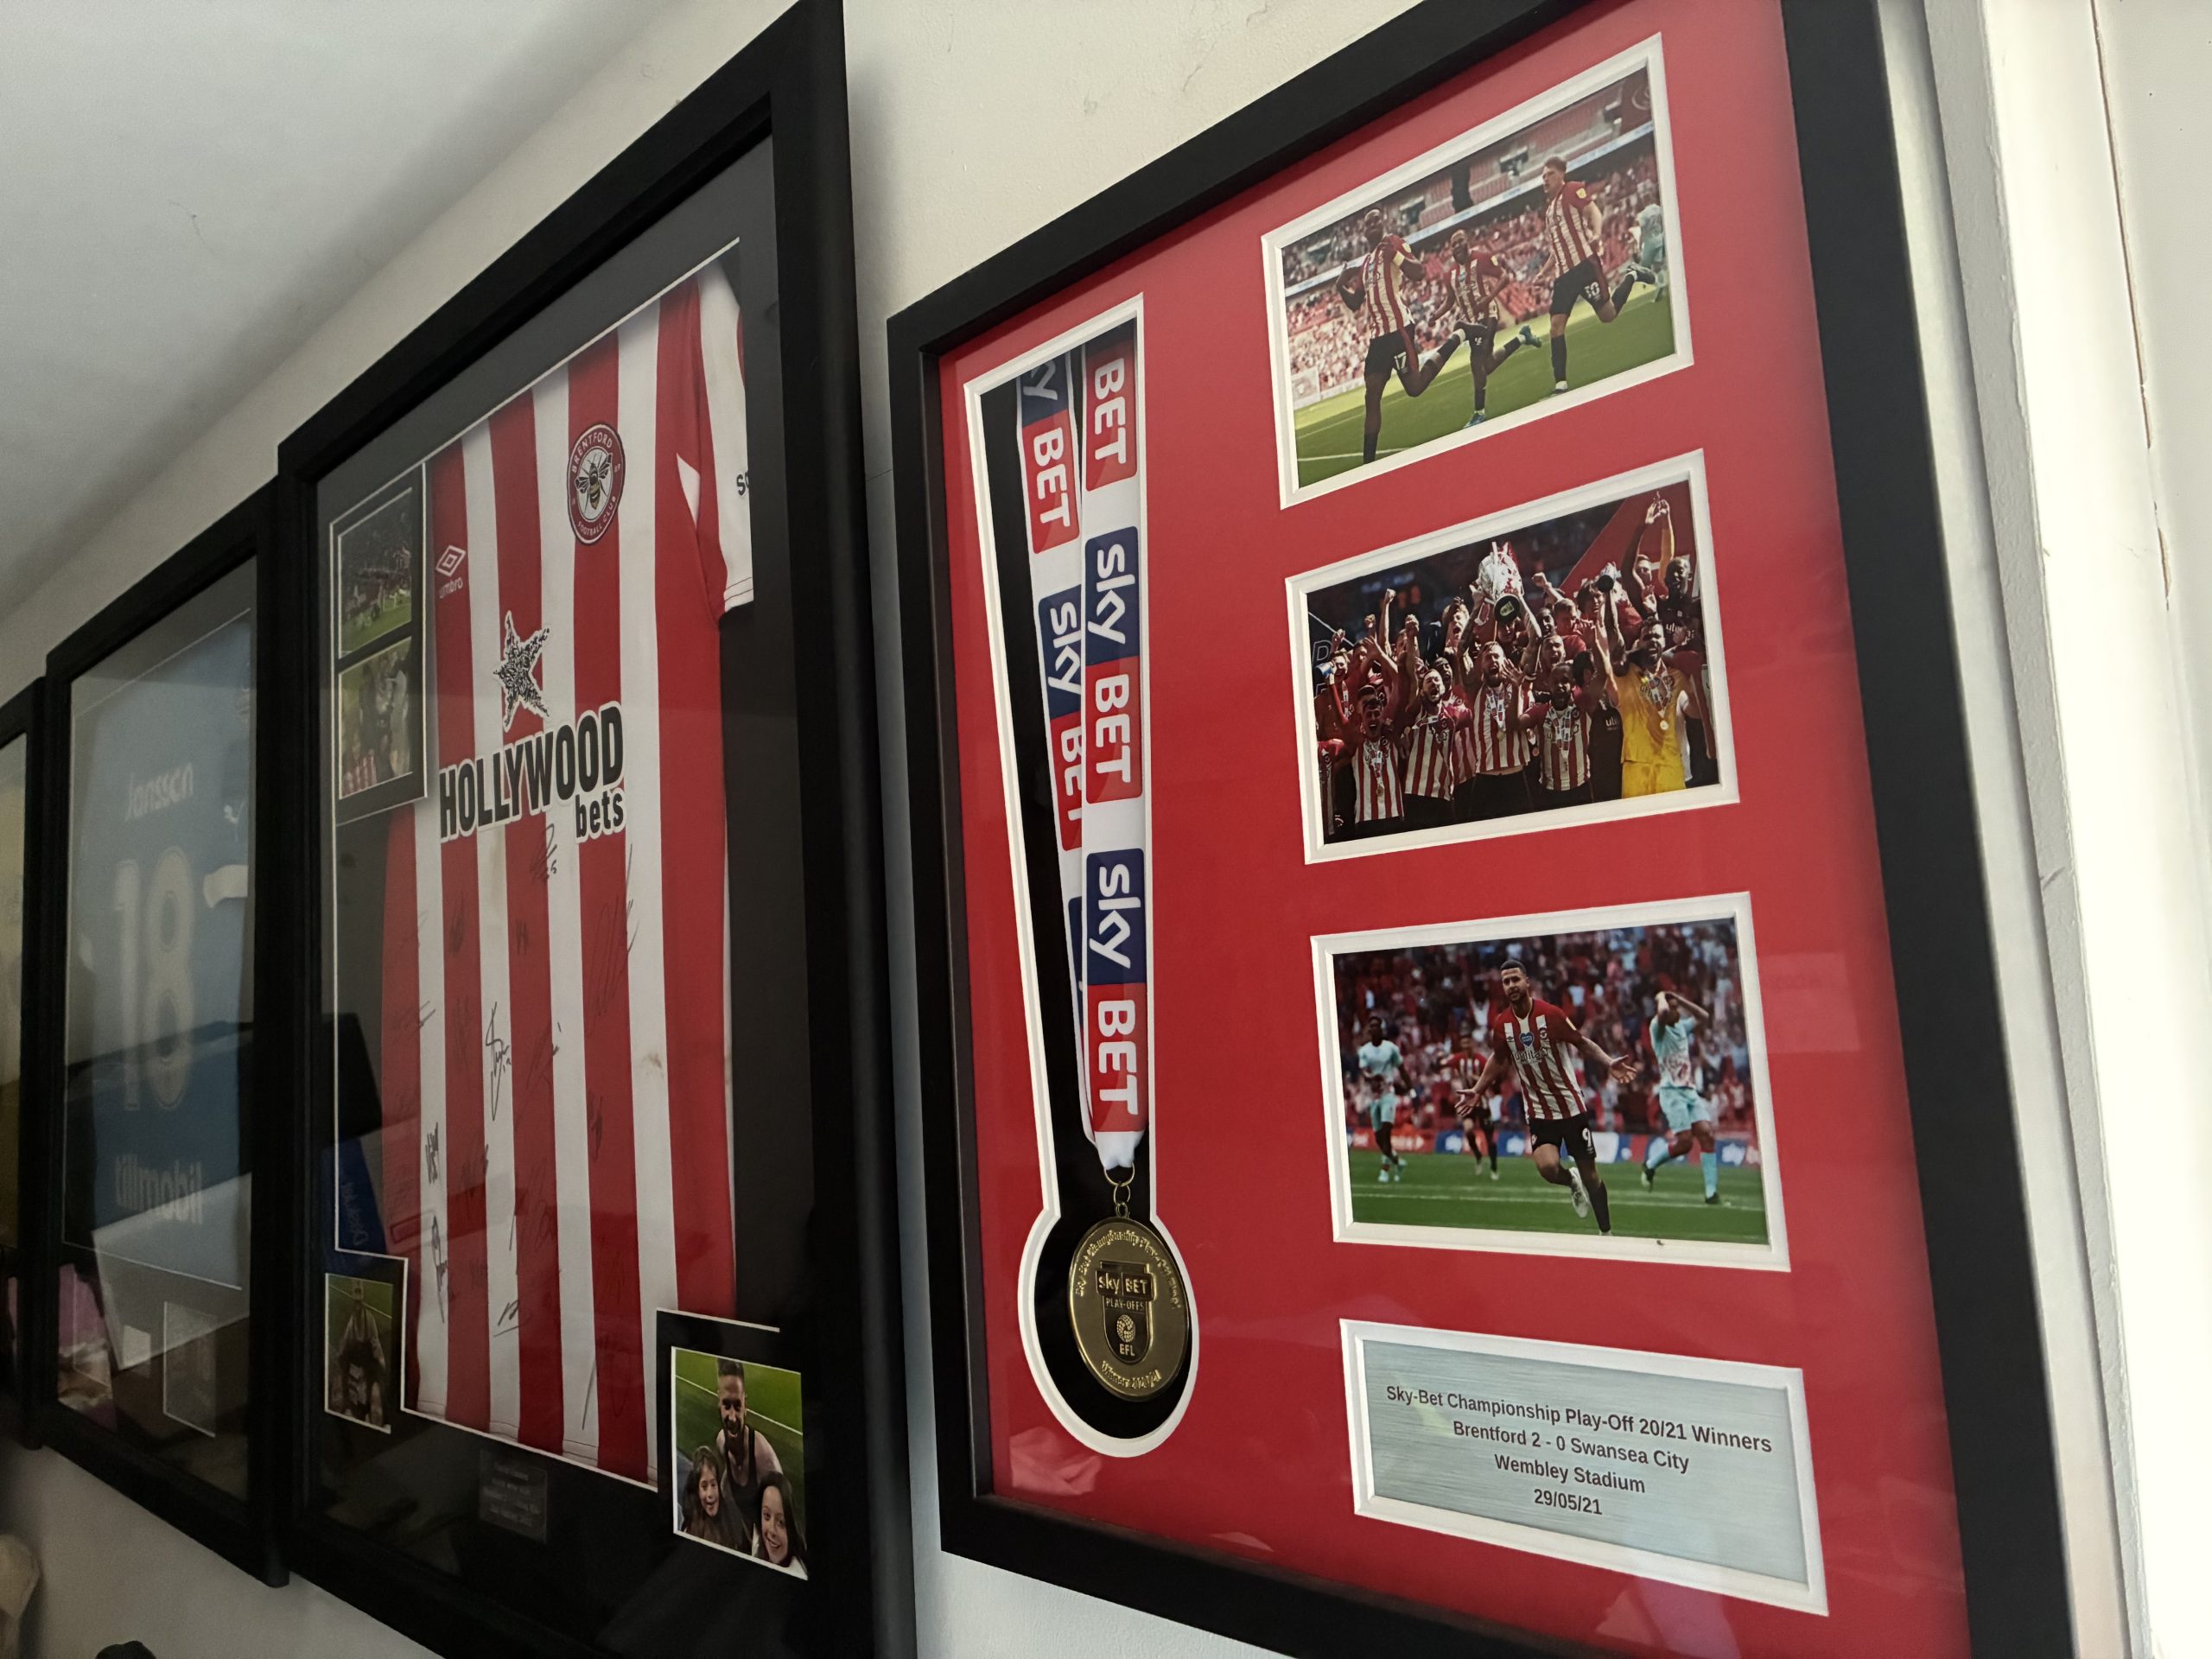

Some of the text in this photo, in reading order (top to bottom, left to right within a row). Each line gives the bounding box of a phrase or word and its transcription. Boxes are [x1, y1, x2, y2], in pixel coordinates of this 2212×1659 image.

[572, 432, 613, 474] BRENTFORD
[1033, 426, 1072, 528] BET
[1087, 357, 1142, 1116] BET sky BET sky BET
[439, 706, 624, 839] HOLLYWOOD
[575, 791, 624, 838] bets
[115, 845, 194, 1110] 18
[1106, 1296, 1145, 1311] PLAY-OFFS
[1125, 1278, 1147, 1294] BET
[1120, 1344, 1136, 1357] EFL
[1386, 1384, 1773, 1453] Sky-Bet Championship Play-Off 20/21 Winners
[1453, 1421, 1527, 1446] Brentford
[1531, 1433, 1541, 1447] 2
[1556, 1435, 1567, 1452] 0
[1570, 1438, 1649, 1465] Swansea
[1653, 1448, 1690, 1474] City
[1494, 1453, 1646, 1494] Wembley Stadium
[1533, 1488, 1603, 1516] 29/05/21
